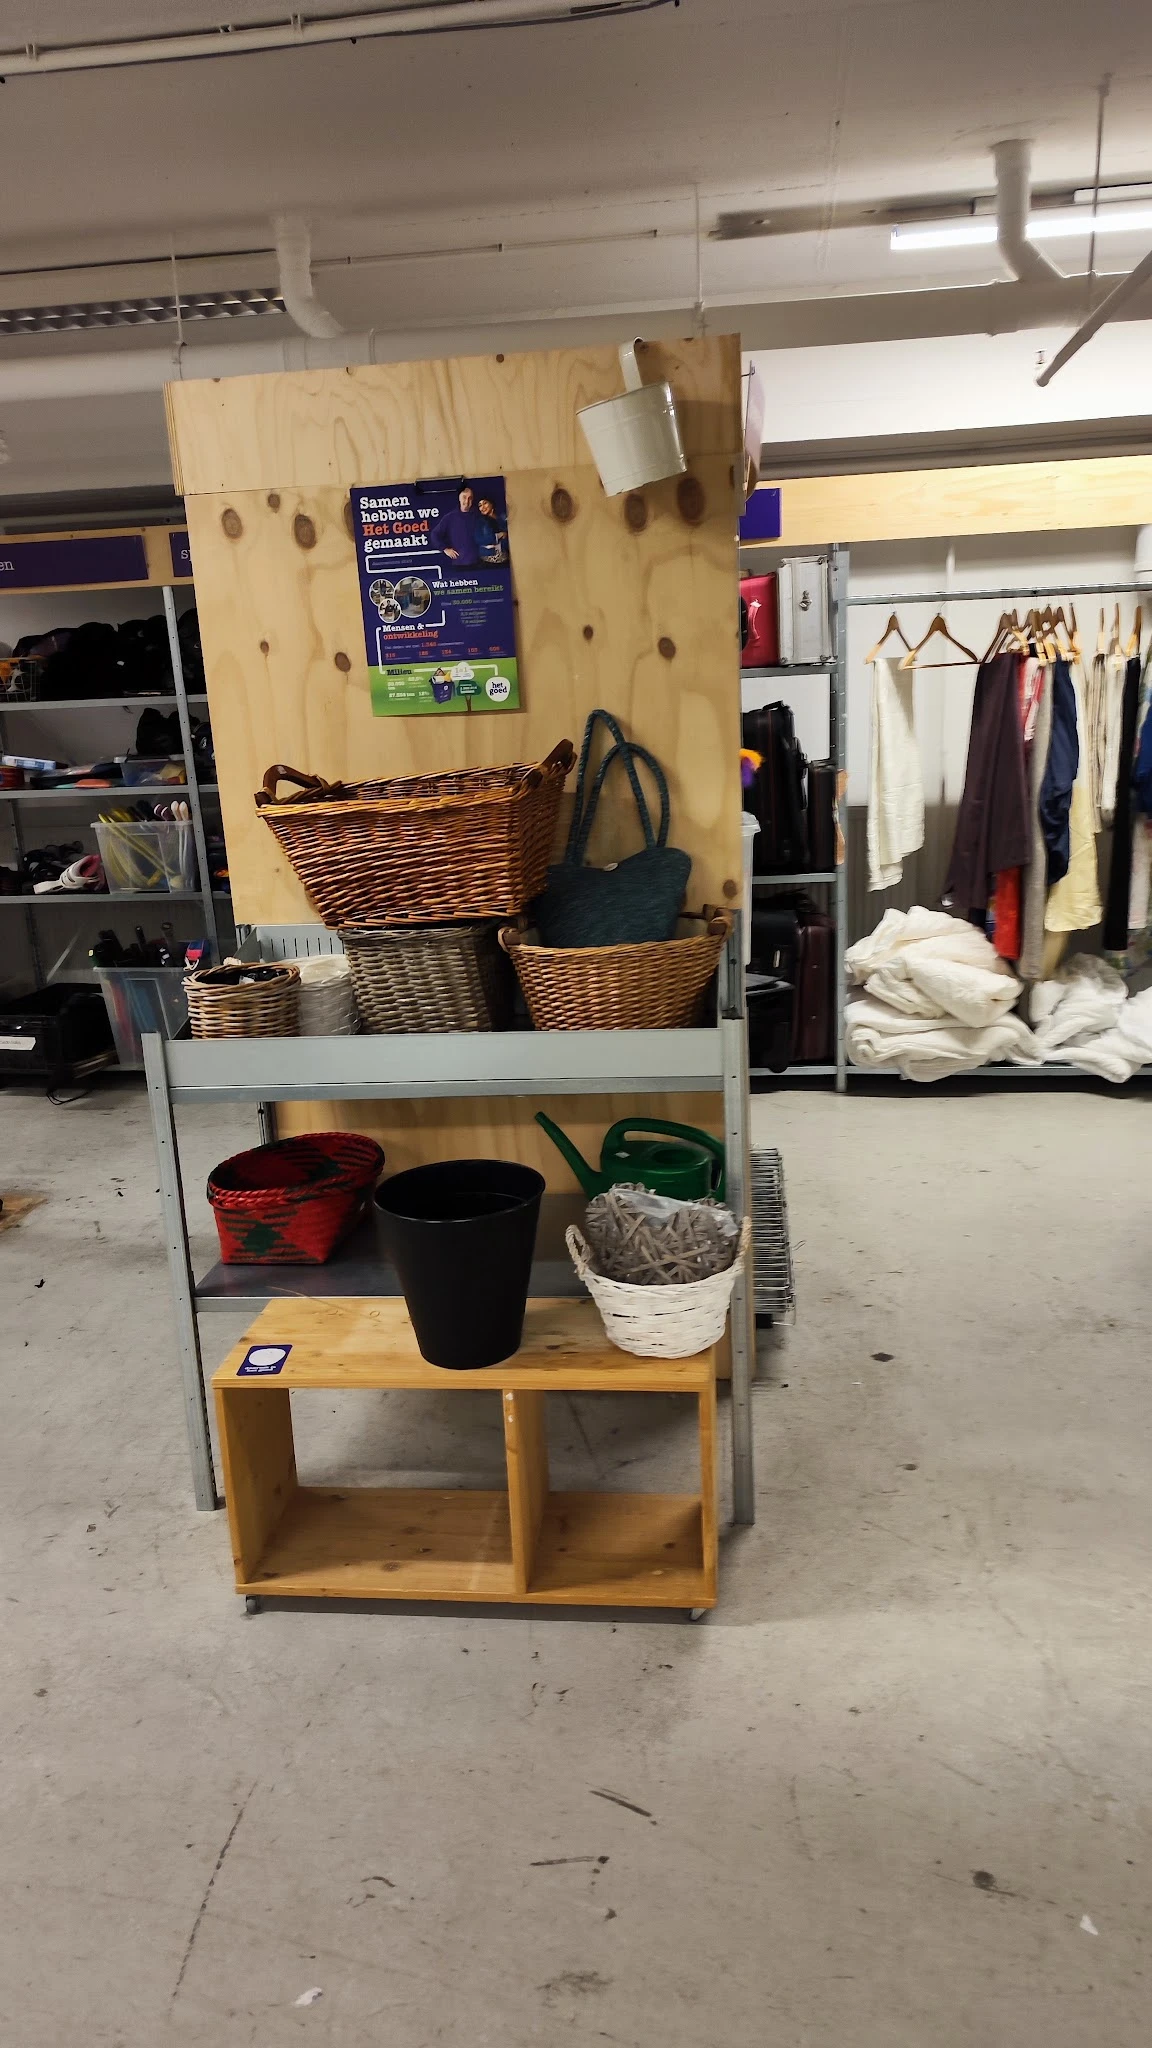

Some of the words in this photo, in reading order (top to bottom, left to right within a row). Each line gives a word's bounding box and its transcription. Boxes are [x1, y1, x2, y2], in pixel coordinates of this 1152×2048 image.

[360, 496, 410, 509] Samen
[360, 509, 415, 523] hebben
[417, 507, 440, 518] we
[362, 523, 390, 536] Het
[392, 520, 430, 534] Goed
[364, 534, 428, 553] gemaakt
[432, 581, 449, 589] Wat
[449, 579, 479, 587] hebben
[474, 585, 504, 593] bereikt
[382, 624, 415, 632] Mensen
[383, 630, 438, 640] ontwikkeling
[491, 681, 503, 689] het
[489, 686, 508, 696] goed
